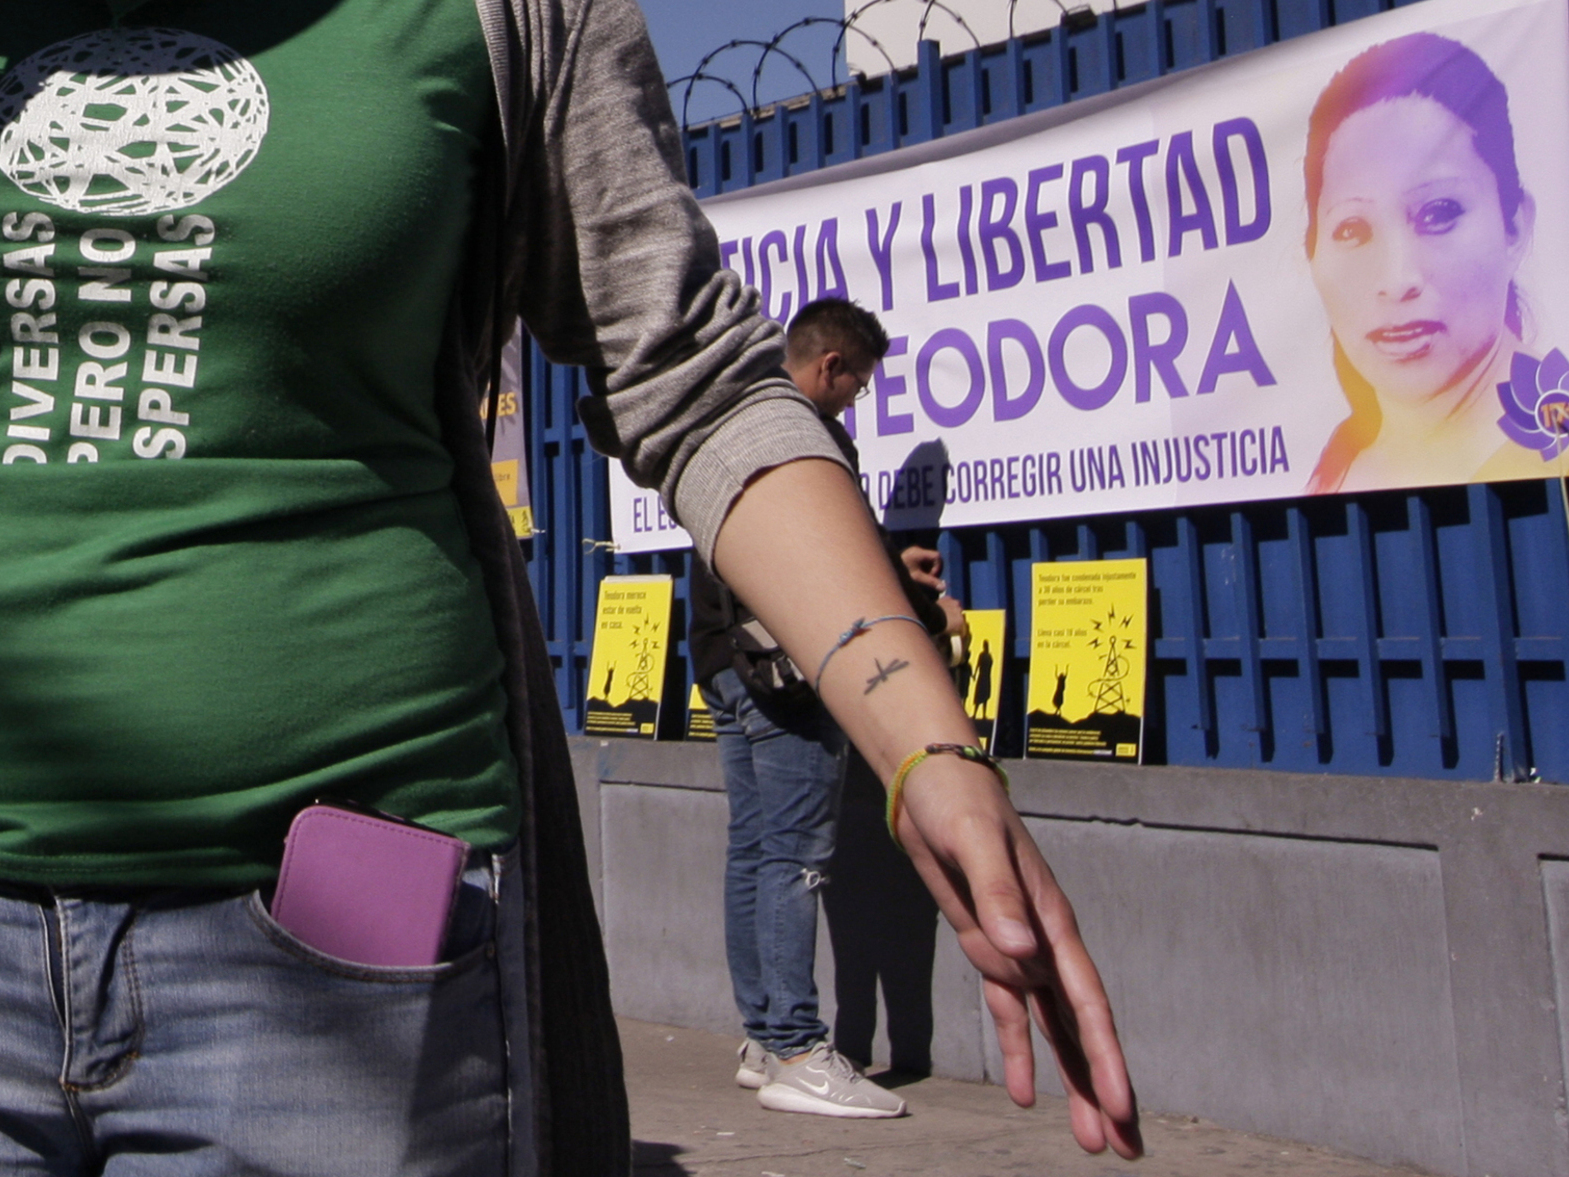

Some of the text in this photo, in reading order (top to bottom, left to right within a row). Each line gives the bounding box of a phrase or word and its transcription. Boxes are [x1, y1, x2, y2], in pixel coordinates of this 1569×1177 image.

[78, 227, 137, 303] NO
[865, 201, 902, 311] Y
[921, 117, 1272, 303] LIBERTAD
[132, 214, 216, 460] SPERSAS
[844, 278, 1278, 440] EODORA
[633, 497, 652, 532] EL
[878, 465, 935, 510] DEBE
[946, 452, 1063, 504] CORREGIR
[1069, 445, 1125, 492] UNA
[1131, 425, 1290, 487] INJUSTICIA
